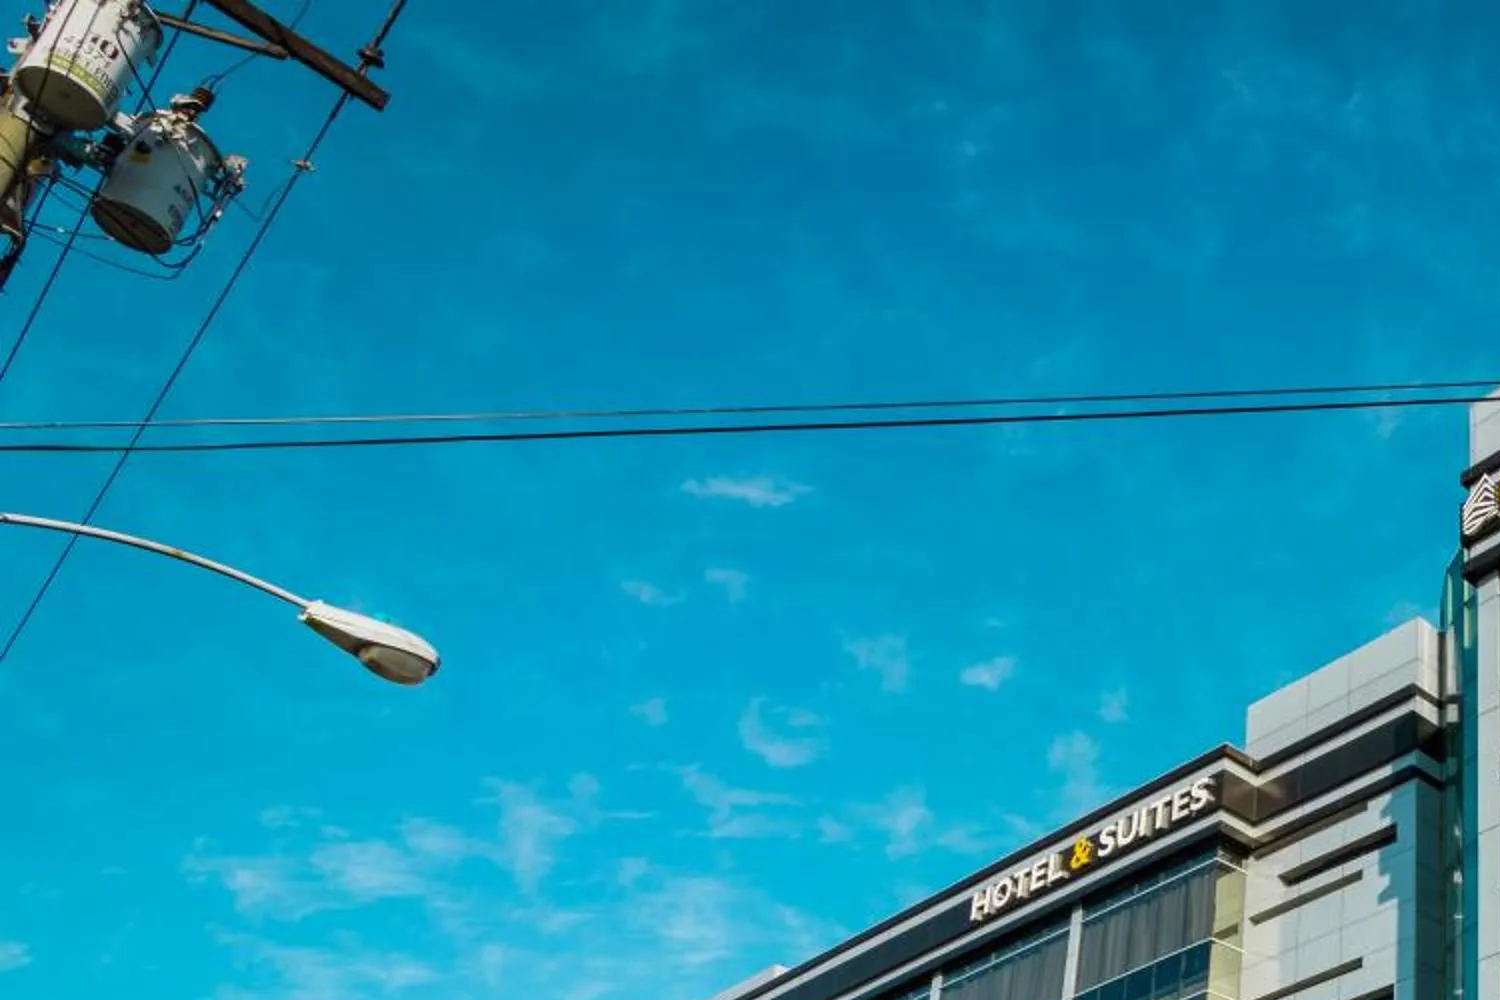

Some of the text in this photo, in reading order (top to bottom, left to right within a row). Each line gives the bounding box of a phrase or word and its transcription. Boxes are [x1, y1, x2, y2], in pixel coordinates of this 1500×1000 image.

[969, 777, 1215, 921] HOTEL & SUITES
